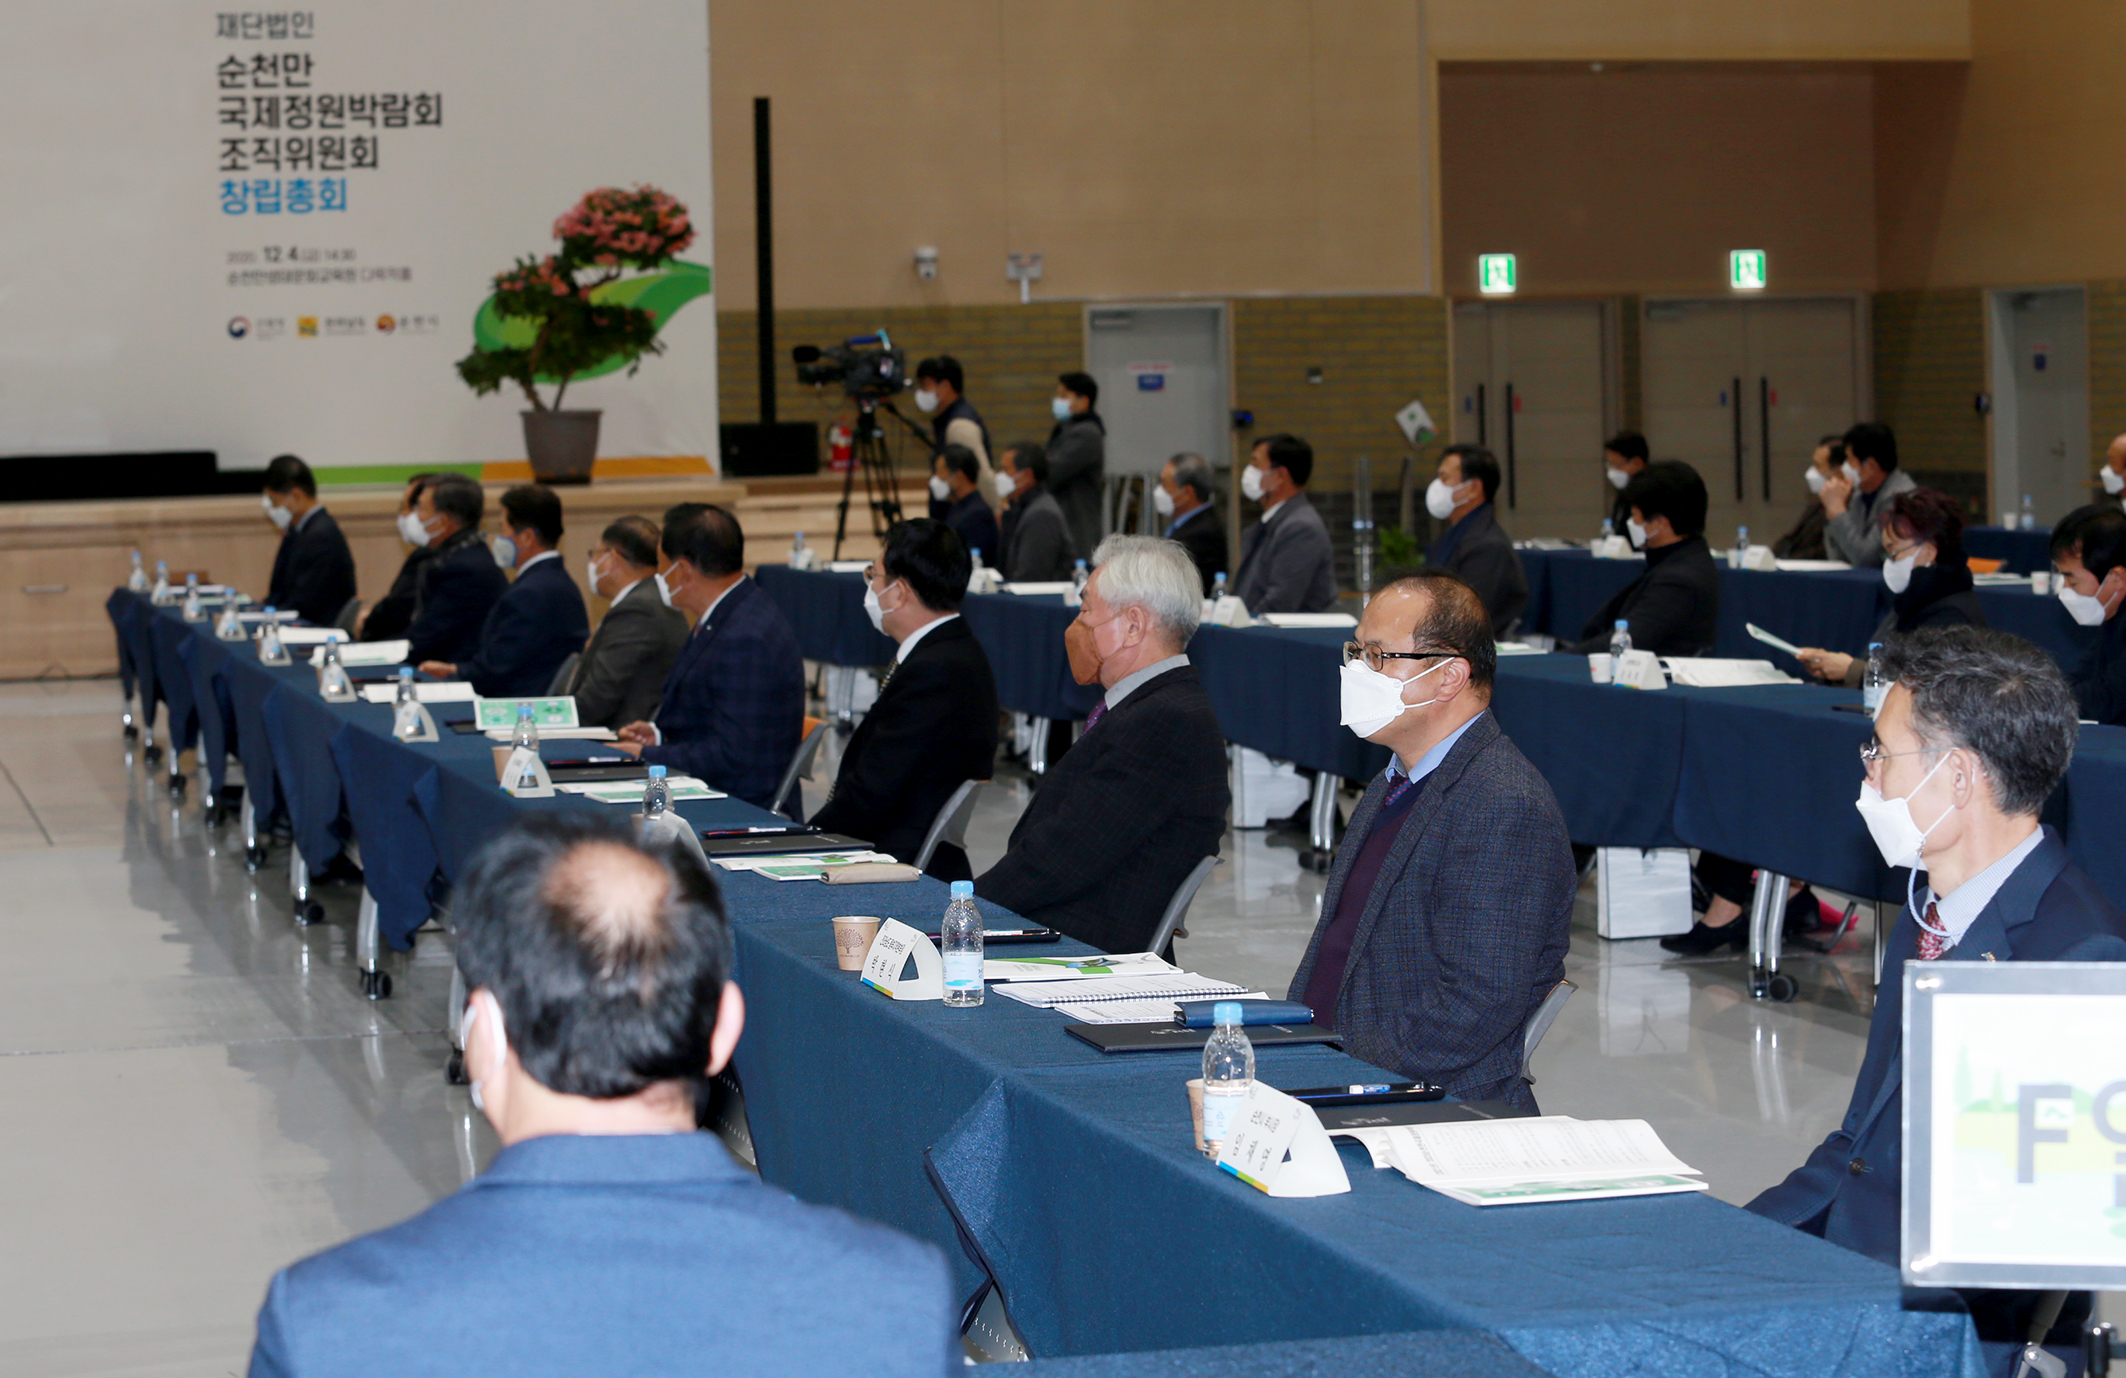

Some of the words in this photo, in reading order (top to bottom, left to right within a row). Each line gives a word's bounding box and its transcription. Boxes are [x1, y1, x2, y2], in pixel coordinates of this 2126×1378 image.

[216, 12, 314, 40] 재단법인
[217, 52, 315, 90] 순천만
[217, 93, 443, 131] 국제정원박람회
[218, 135, 379, 172] 조직위원회
[219, 177, 348, 216] 창립총회
